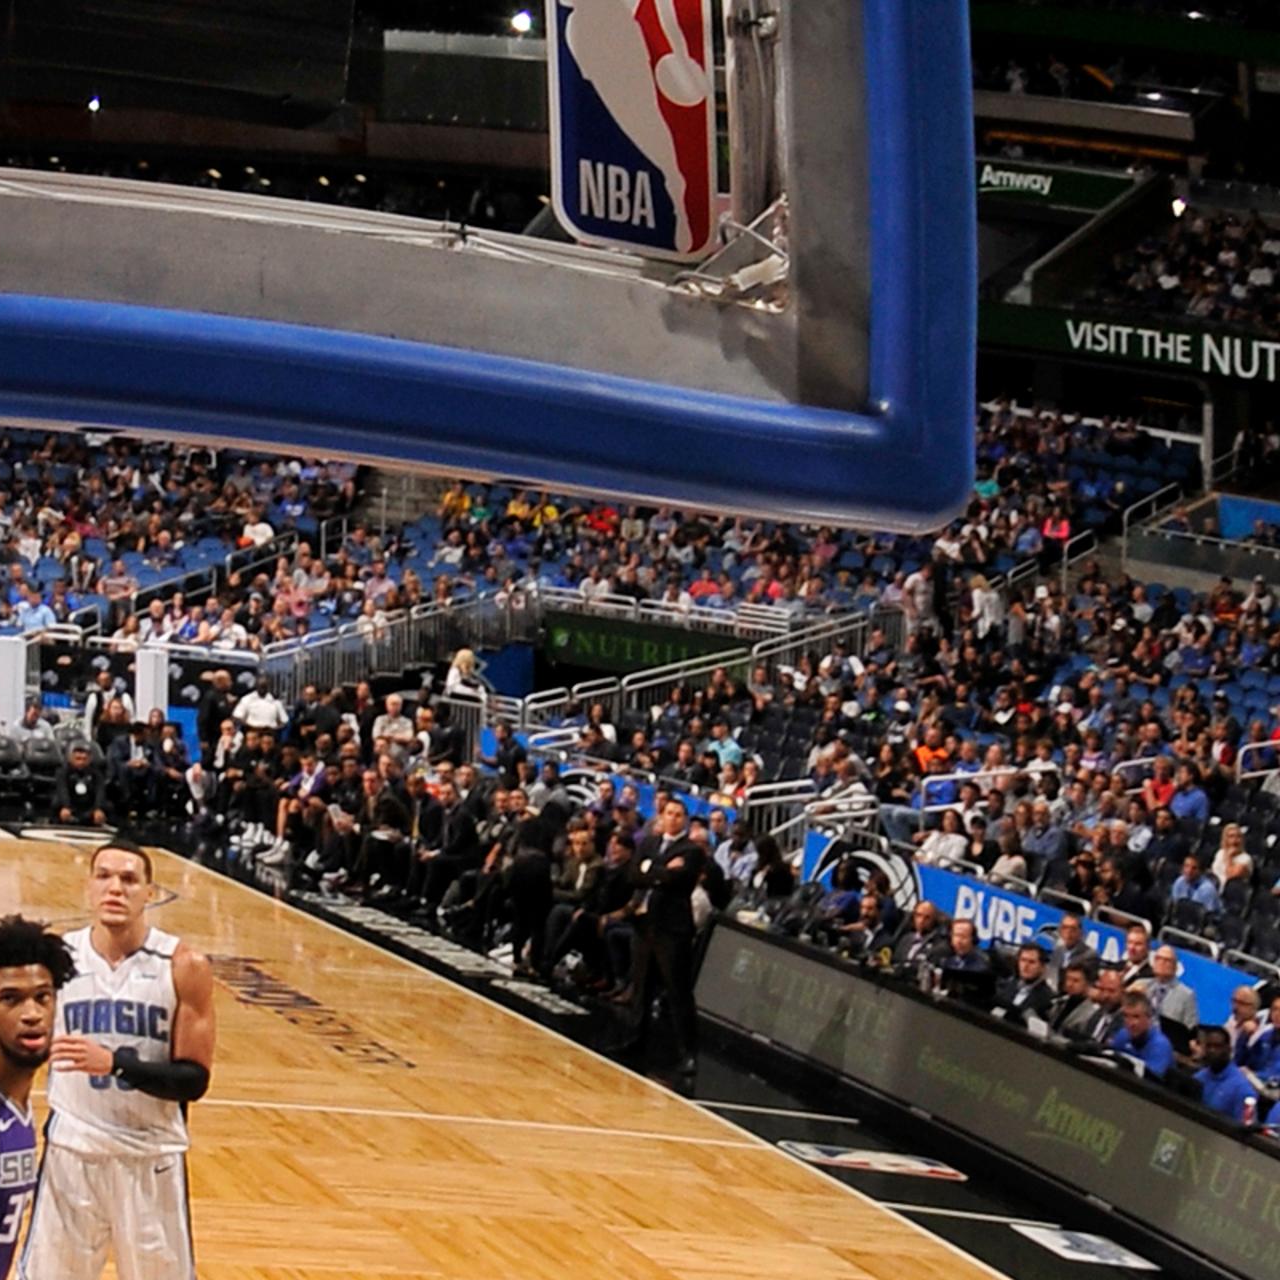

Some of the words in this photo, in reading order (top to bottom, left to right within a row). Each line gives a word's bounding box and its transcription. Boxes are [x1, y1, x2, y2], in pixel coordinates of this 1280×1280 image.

[579, 157, 656, 230] NBA
[980, 164, 1053, 196] Amway
[1065, 318, 1134, 355] VISIT
[1137, 328, 1192, 364] THE
[1202, 333, 1280, 382] NUT
[63, 998, 170, 1042] MAGIC
